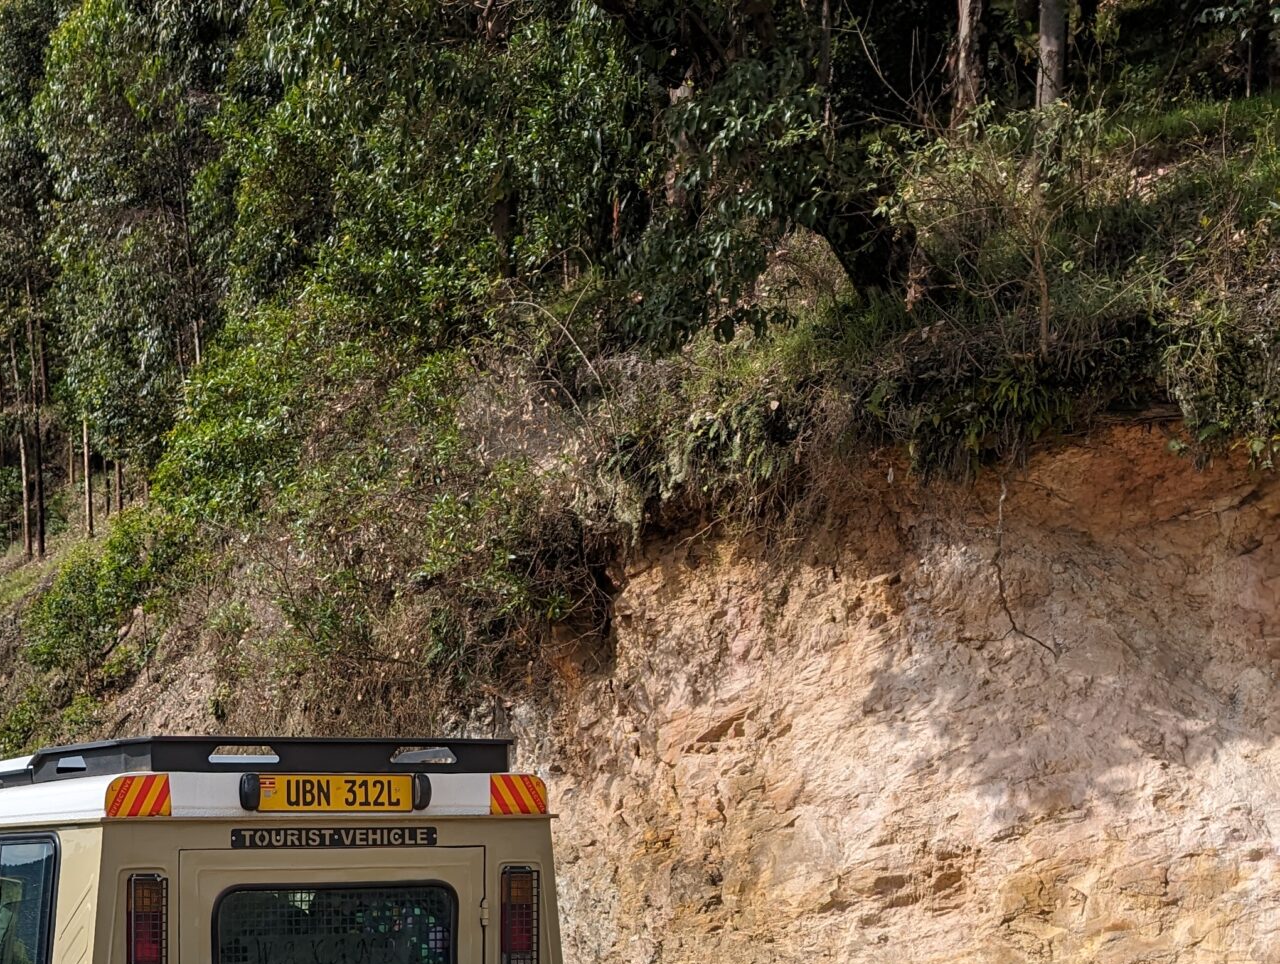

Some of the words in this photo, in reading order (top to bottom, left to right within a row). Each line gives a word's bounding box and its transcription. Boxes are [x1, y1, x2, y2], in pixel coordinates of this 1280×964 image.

[108, 777, 133, 817] REFLECTIVE
[286, 779, 331, 807] UBN
[344, 779, 401, 807] 312L
[523, 777, 546, 813] REFLECTIVE
[241, 829, 334, 847] TOURIST
[341, 829, 428, 846] VEHICLE
